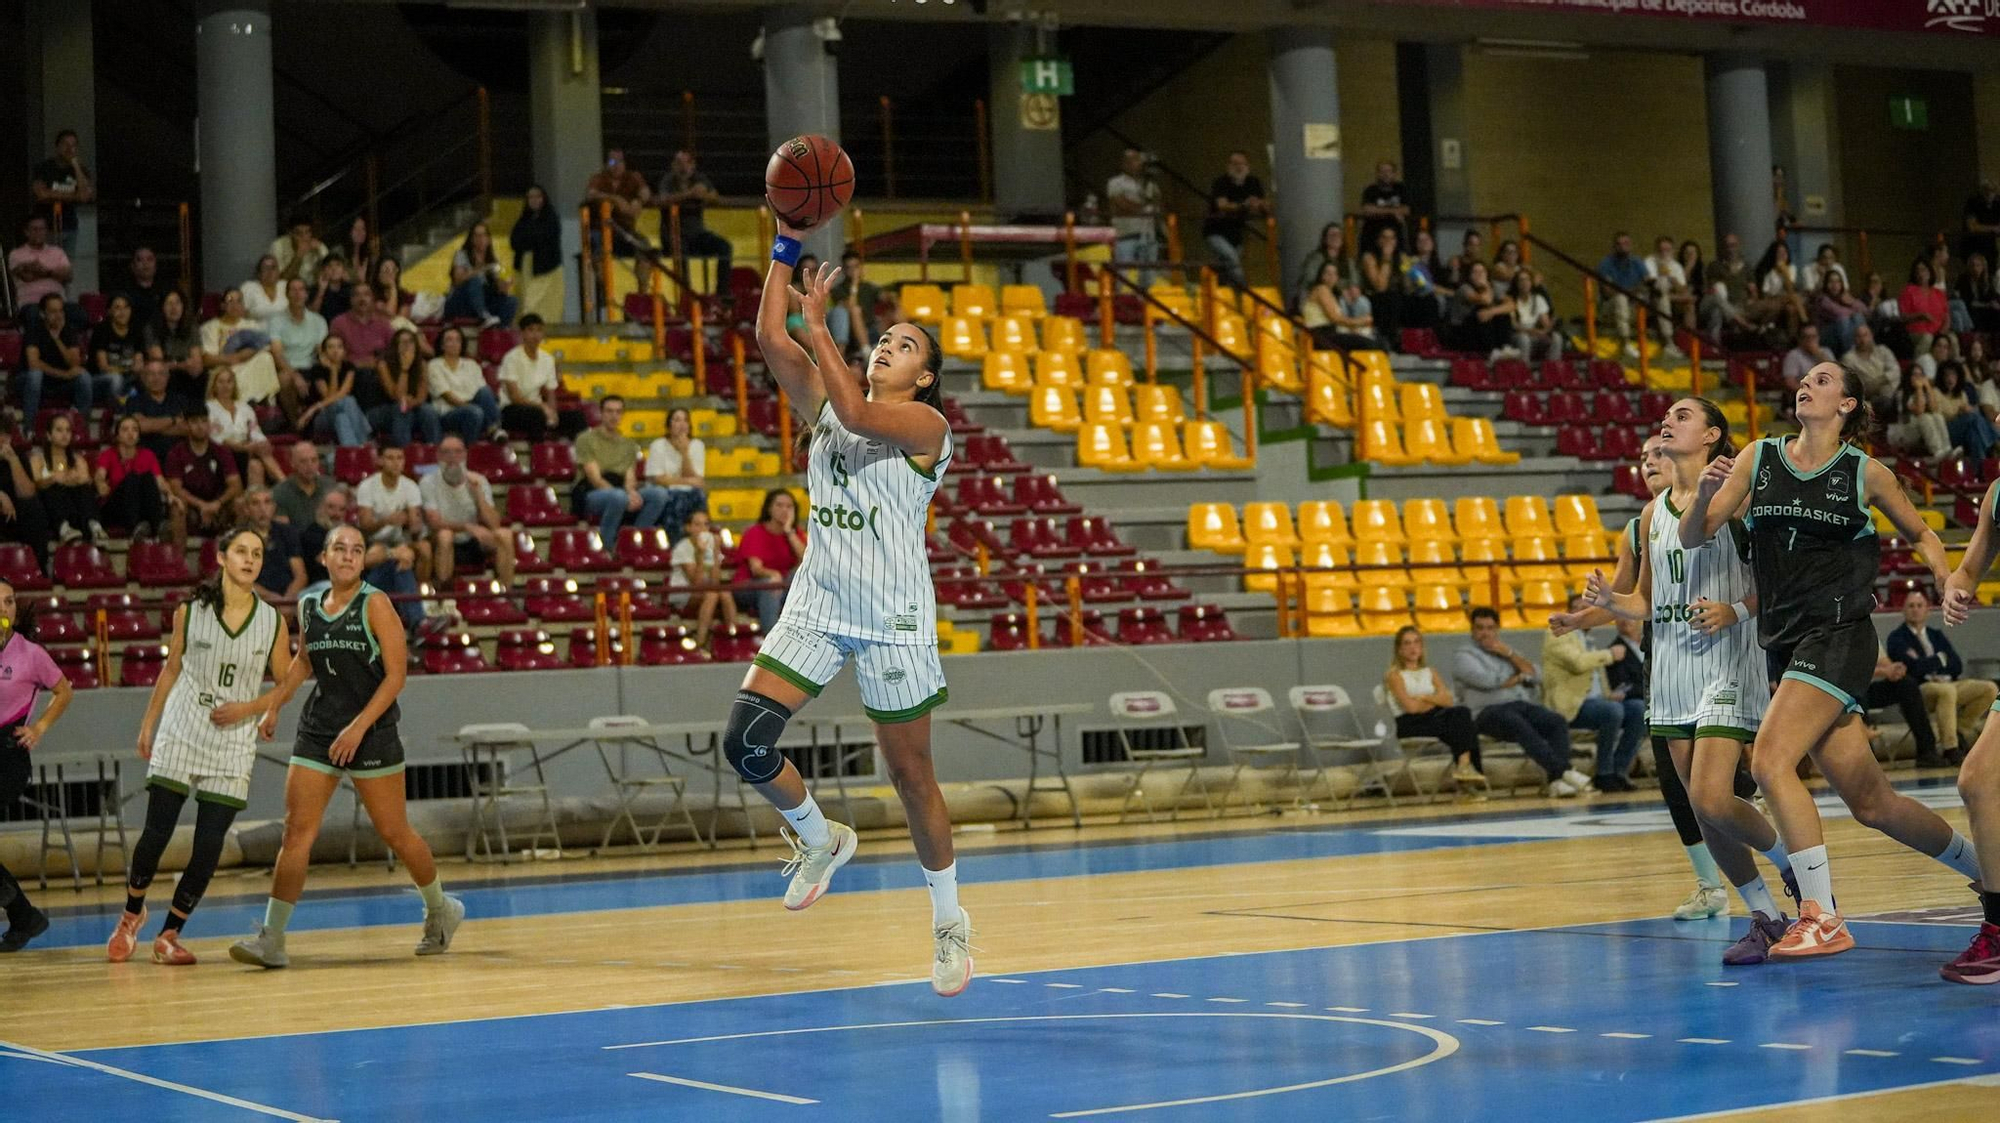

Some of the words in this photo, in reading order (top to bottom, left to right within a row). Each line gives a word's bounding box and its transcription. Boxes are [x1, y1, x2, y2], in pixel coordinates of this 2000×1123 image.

[1666, 0, 1738, 17] Deportes
[1036, 60, 1059, 88] H
[1825, 493, 1850, 502] vive
[1752, 505, 1851, 527] CORDOBASKET
[1788, 526, 1798, 551] 7
[1667, 549, 1685, 585] 10
[306, 639, 368, 652] RDOBASKET
[217, 662, 237, 687] 16
[1794, 660, 1817, 671] vive
